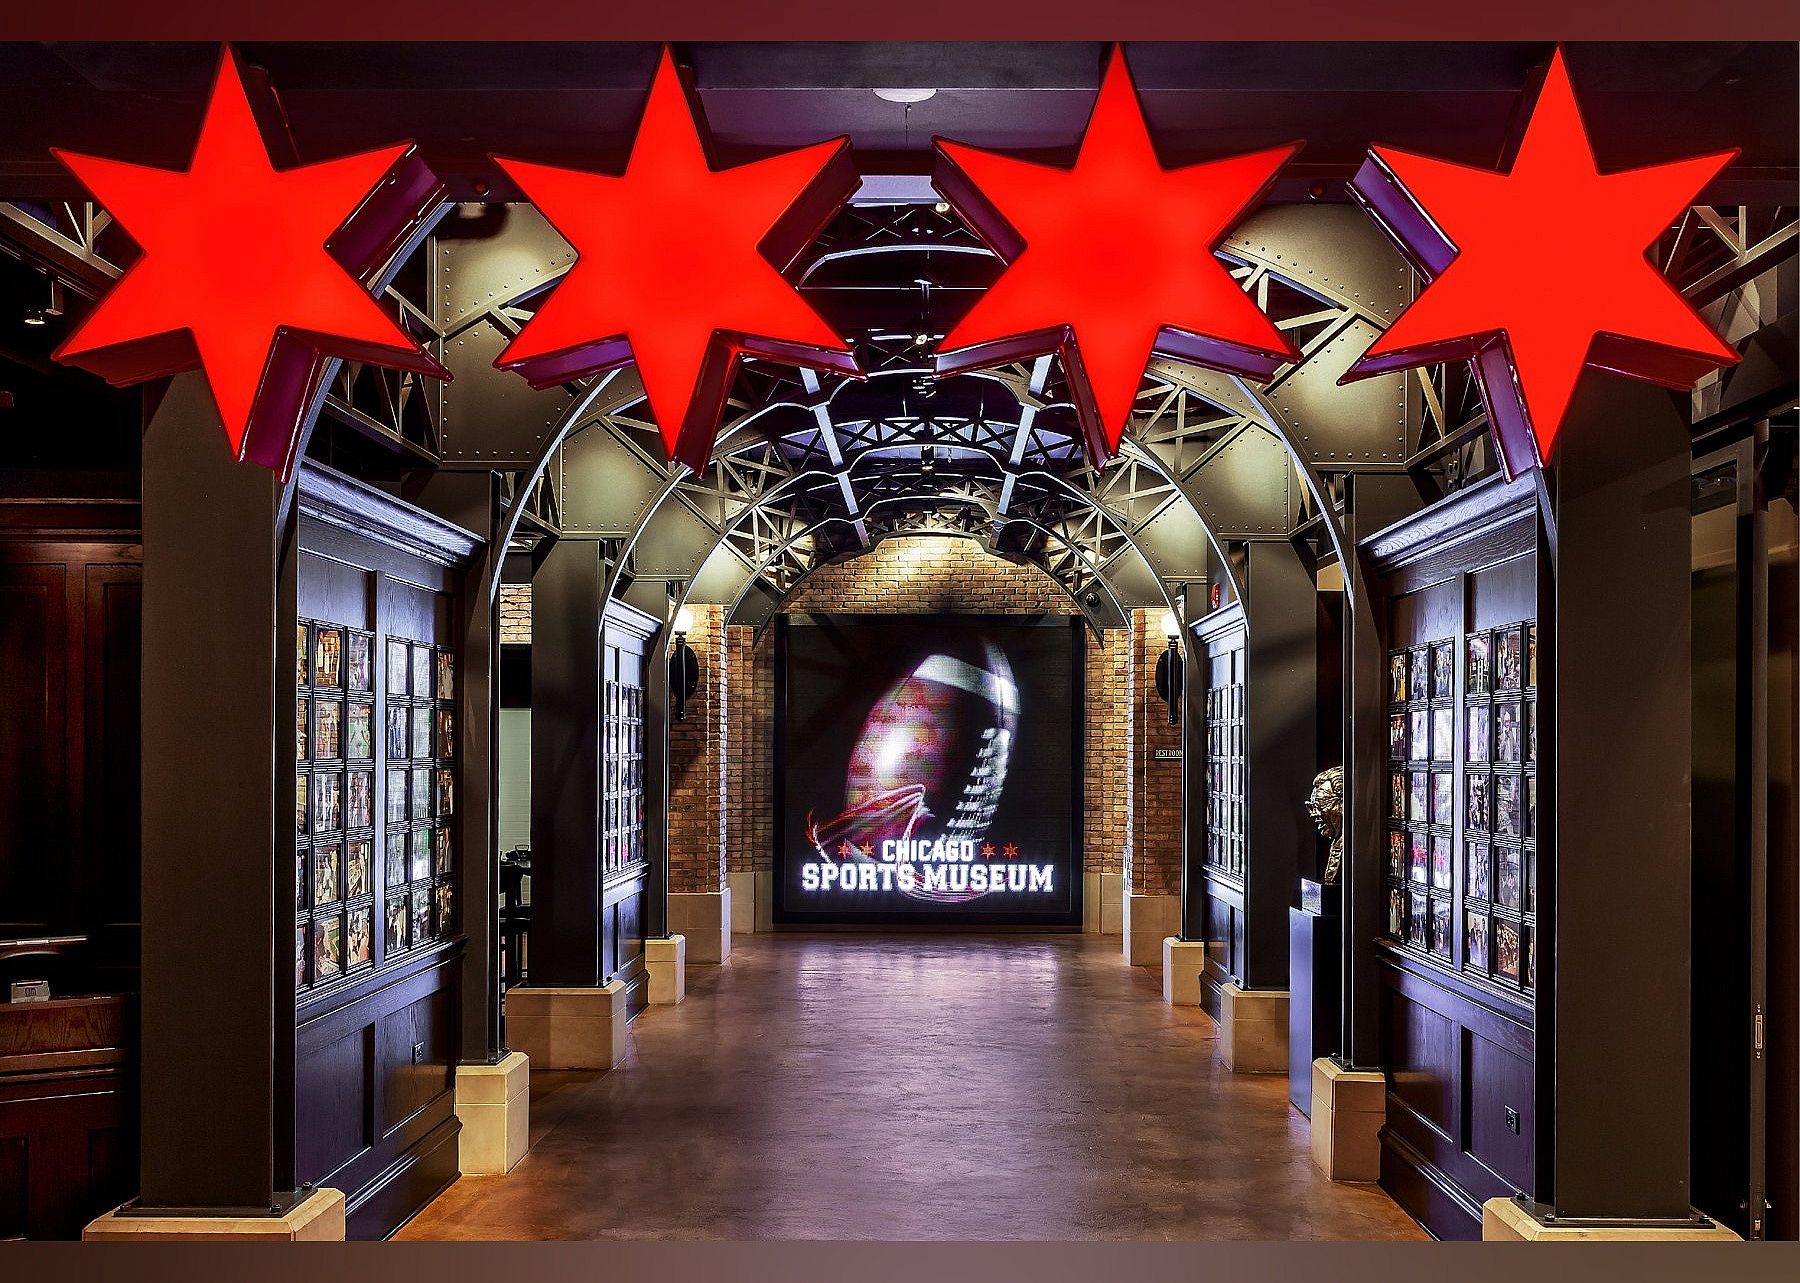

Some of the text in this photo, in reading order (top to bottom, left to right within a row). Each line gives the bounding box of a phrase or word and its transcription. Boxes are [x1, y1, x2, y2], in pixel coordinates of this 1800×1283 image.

[882, 839, 975, 862] CHICAGO
[801, 862, 1055, 893] SPORTS MUSEUM
